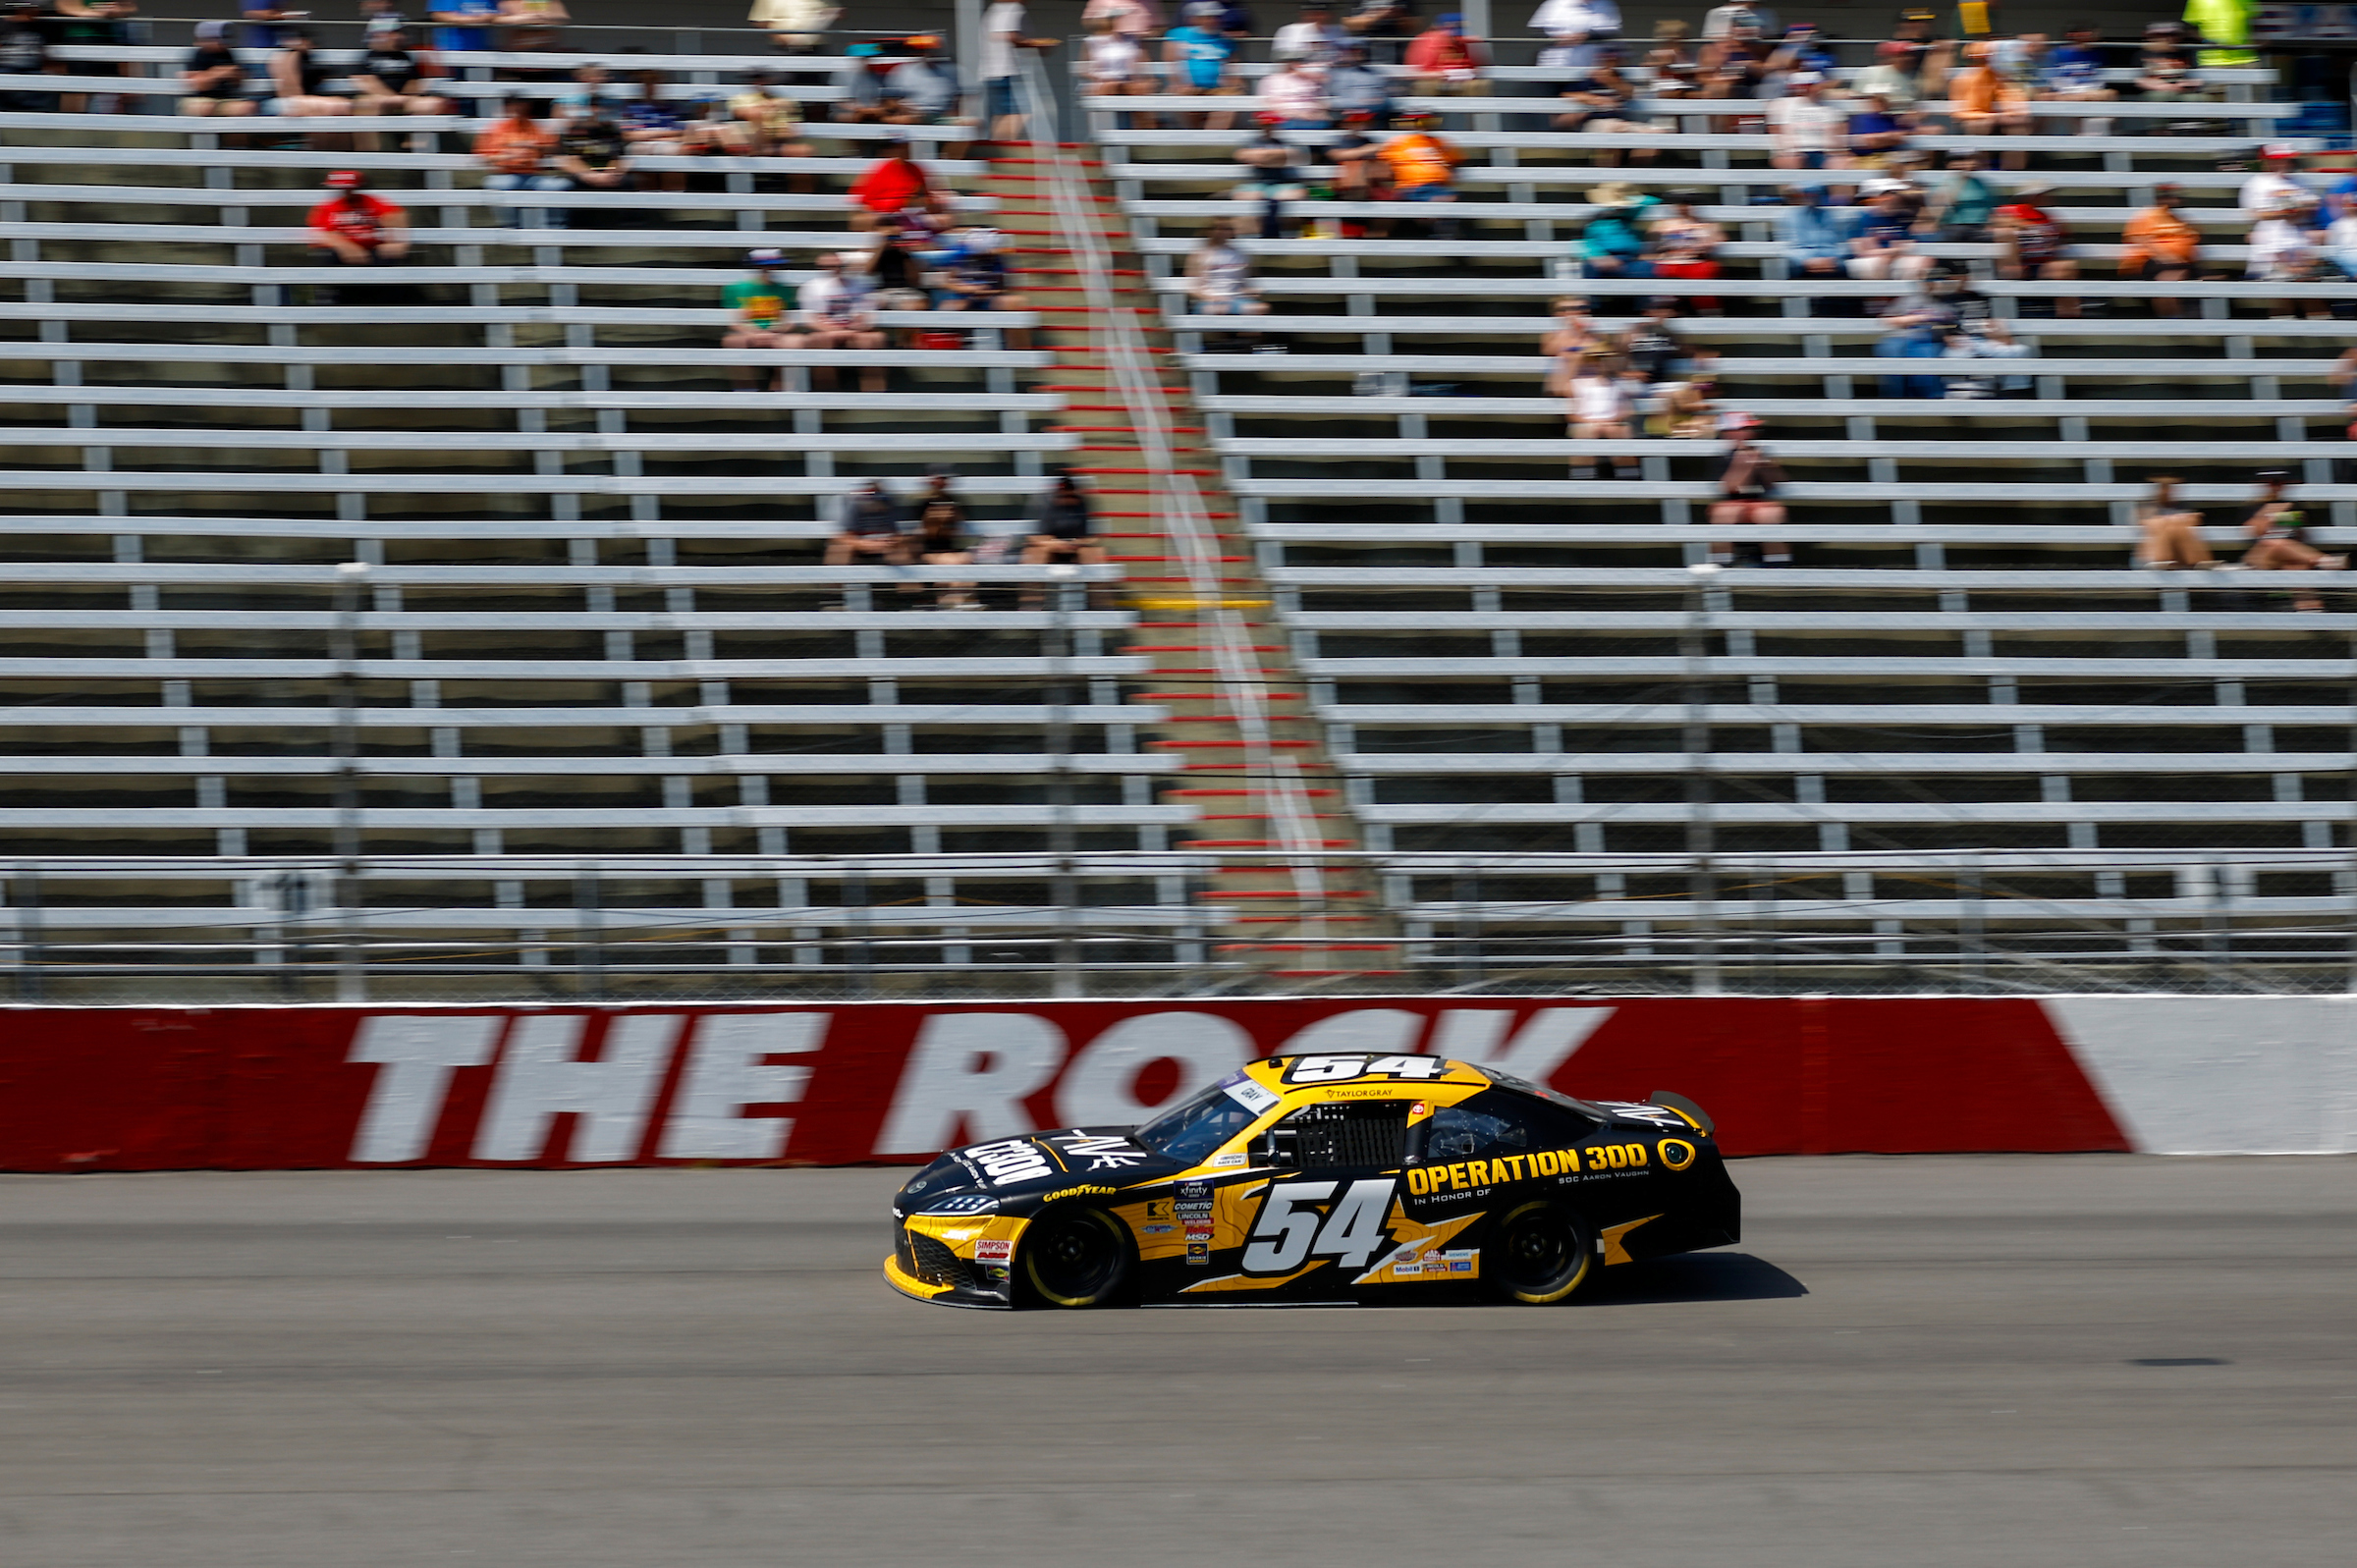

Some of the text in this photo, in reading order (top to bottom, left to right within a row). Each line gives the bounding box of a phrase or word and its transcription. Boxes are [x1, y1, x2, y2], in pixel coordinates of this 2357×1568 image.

[1291, 1054, 1442, 1083] 54
[347, 1012, 834, 1162] THE
[1240, 1087, 1264, 1102] GRAY
[1406, 1143, 1649, 1196] OPERATION 300
[1042, 1183, 1117, 1203] GOODYEAR
[1180, 1185, 1208, 1197] xfinity
[1241, 1179, 1397, 1272] 54
[976, 1240, 1011, 1251] SIMPSON
